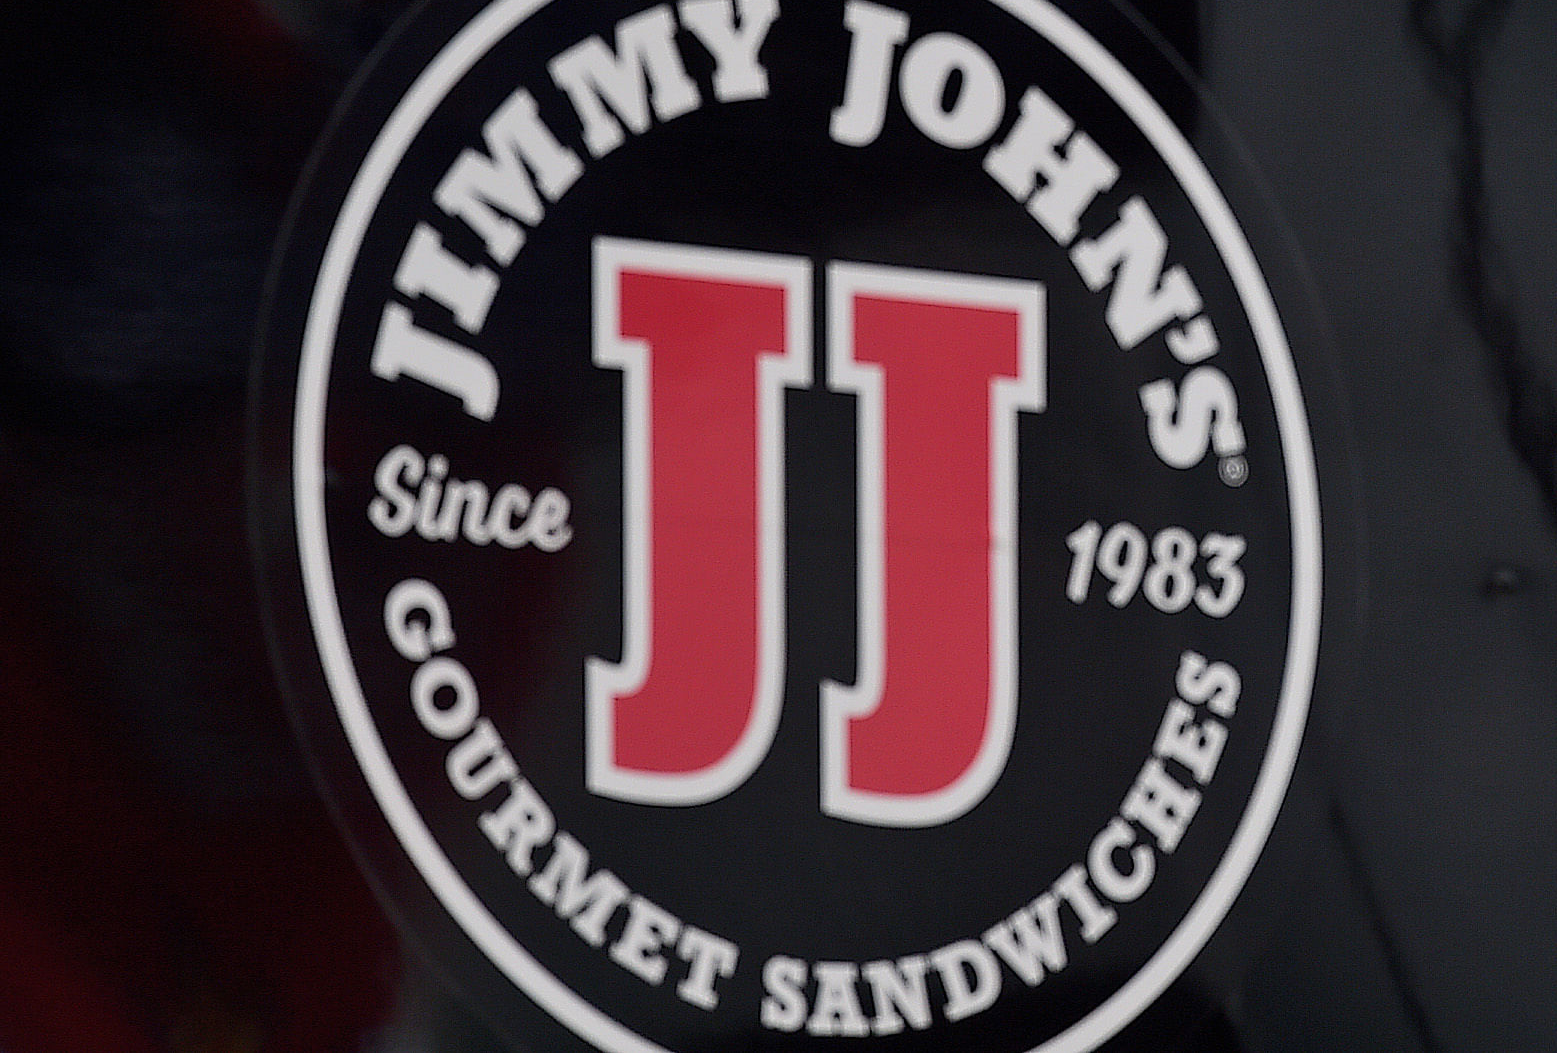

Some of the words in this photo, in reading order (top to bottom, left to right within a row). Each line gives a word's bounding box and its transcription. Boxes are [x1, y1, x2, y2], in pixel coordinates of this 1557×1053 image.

[368, 444, 573, 553] Since
[1066, 519, 1247, 618] 1983
[584, 234, 1047, 829] JJ
[384, 578, 740, 1011] GOURMET
[760, 649, 1243, 1036] SANDWICHES
